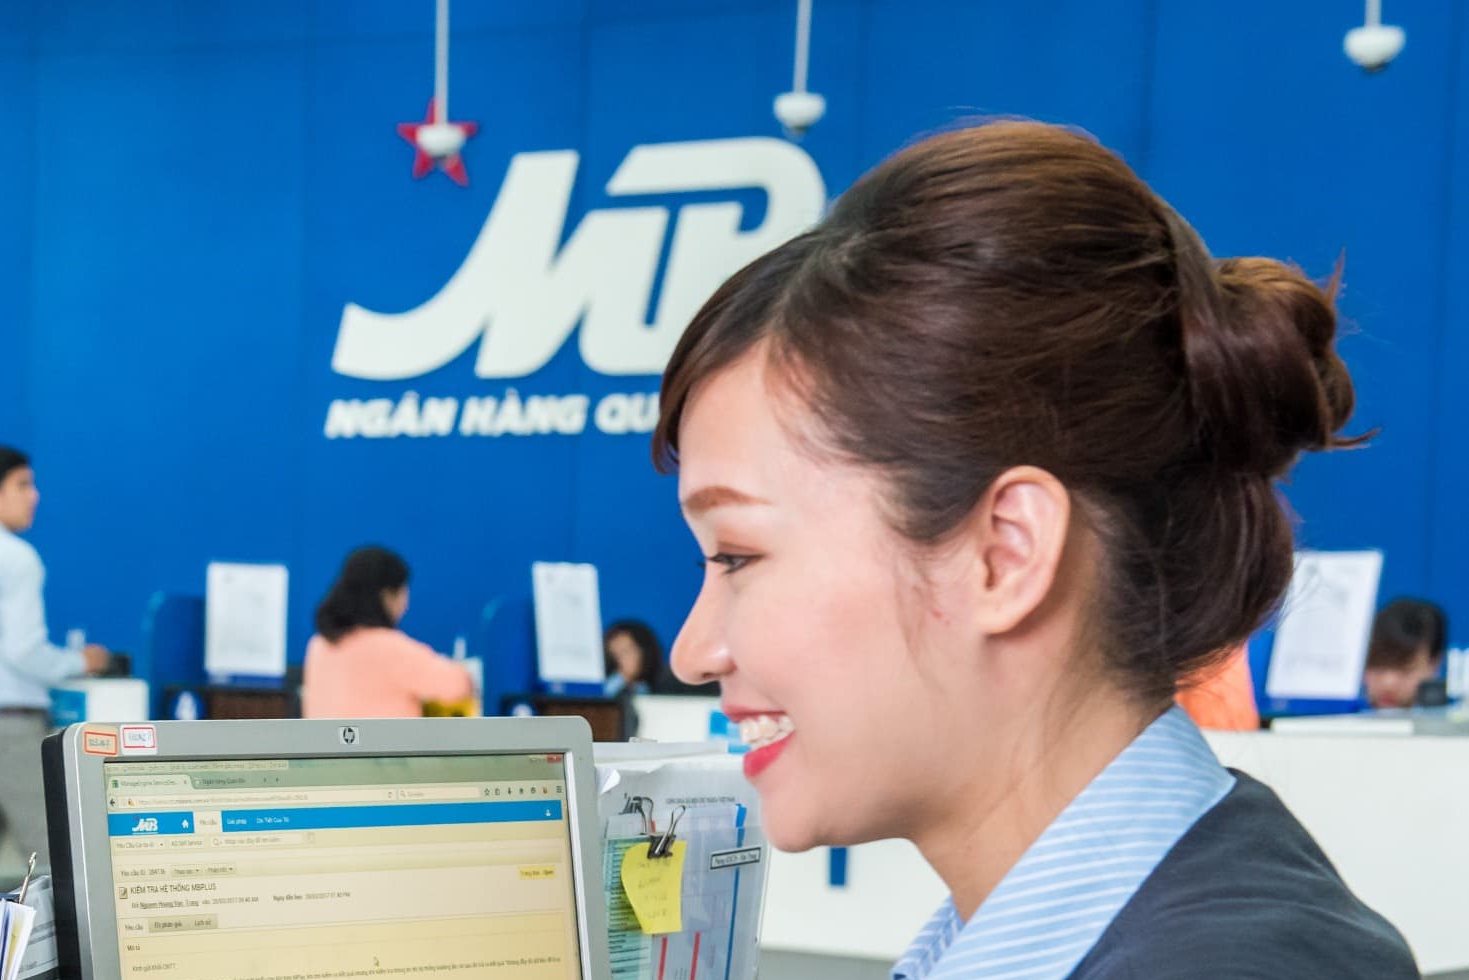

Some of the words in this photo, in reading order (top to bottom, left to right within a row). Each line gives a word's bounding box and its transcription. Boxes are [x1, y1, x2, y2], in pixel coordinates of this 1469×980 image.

[325, 388, 456, 438] NGÂN
[459, 387, 589, 436] HÀNG
[594, 391, 662, 435] QU
